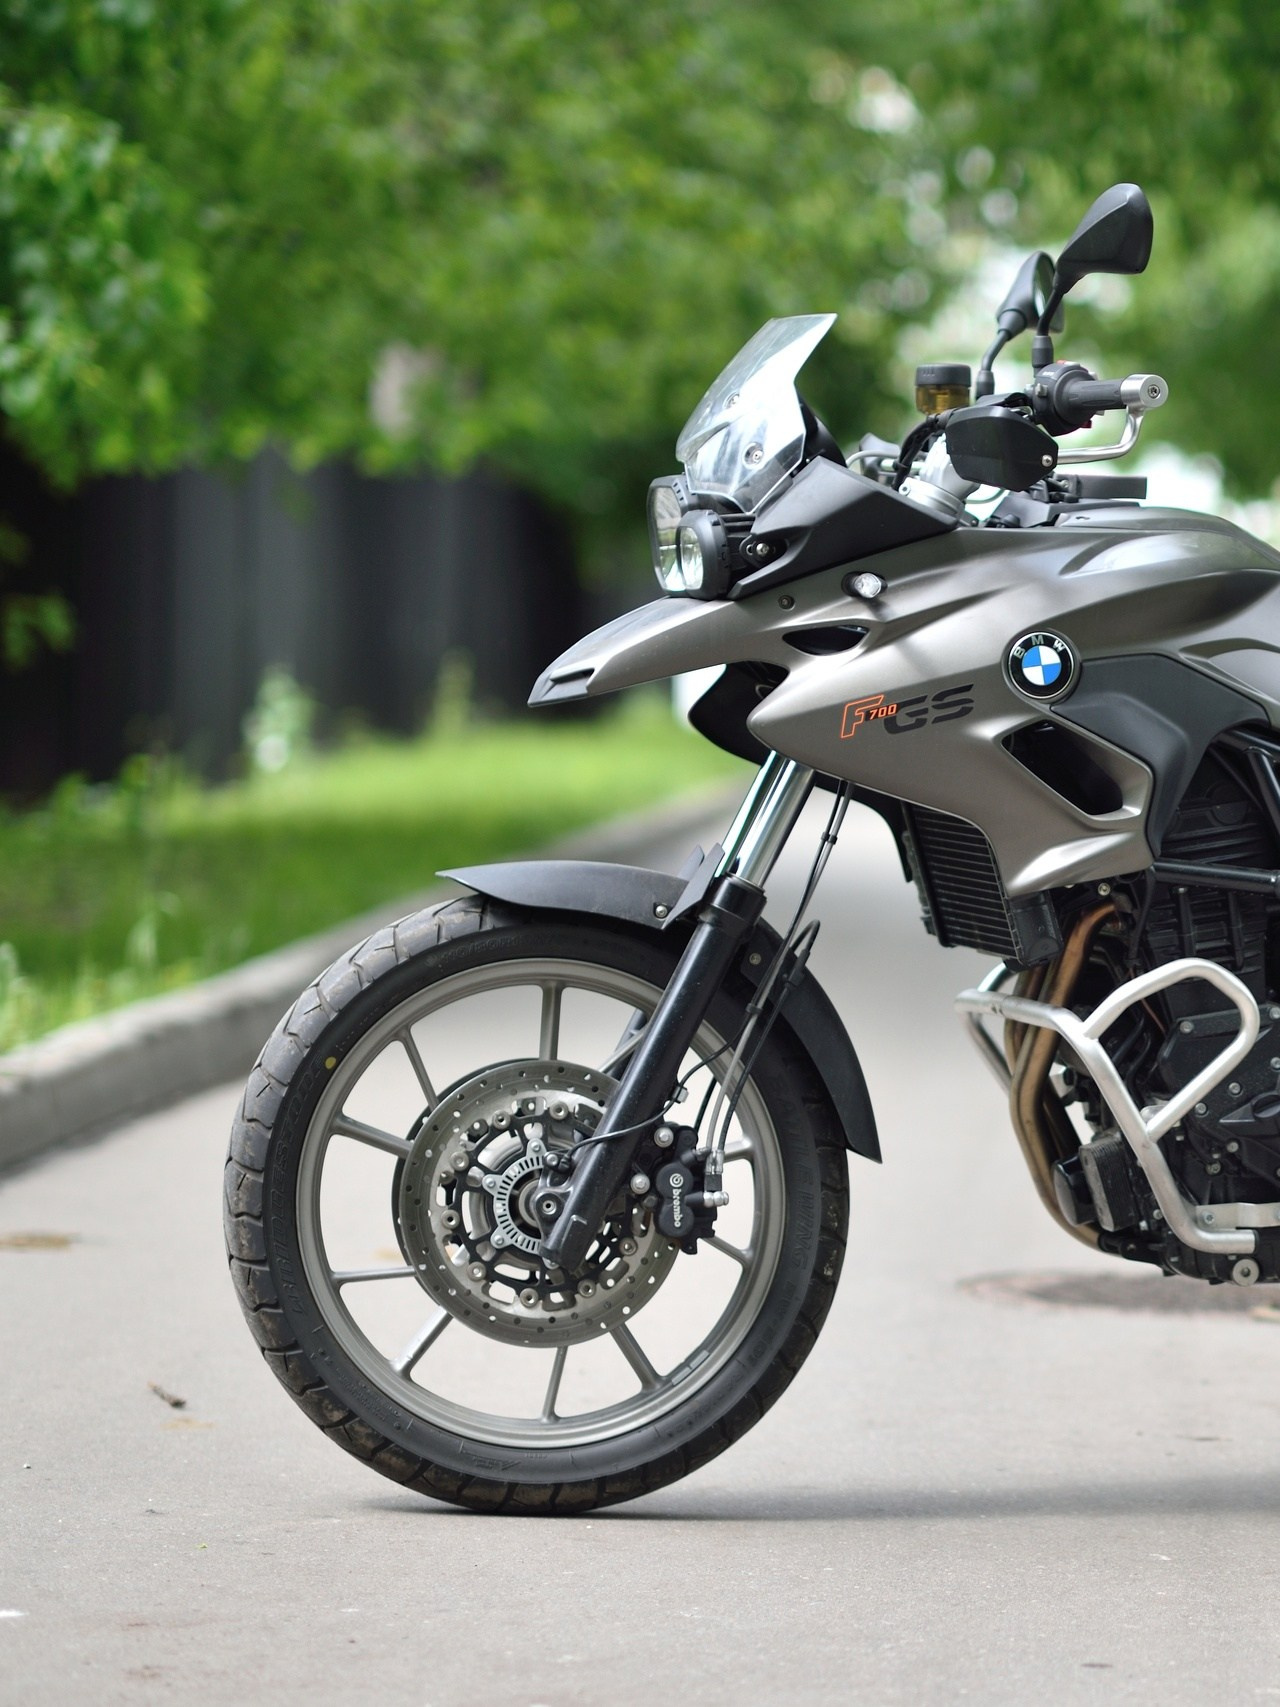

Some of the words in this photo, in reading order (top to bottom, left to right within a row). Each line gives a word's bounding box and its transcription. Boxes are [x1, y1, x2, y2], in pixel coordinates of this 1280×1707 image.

[1013, 634, 1066, 659] BMW
[869, 703, 898, 721] 700
[884, 684, 975, 735] GS
[672, 1188, 682, 1228] brembo
